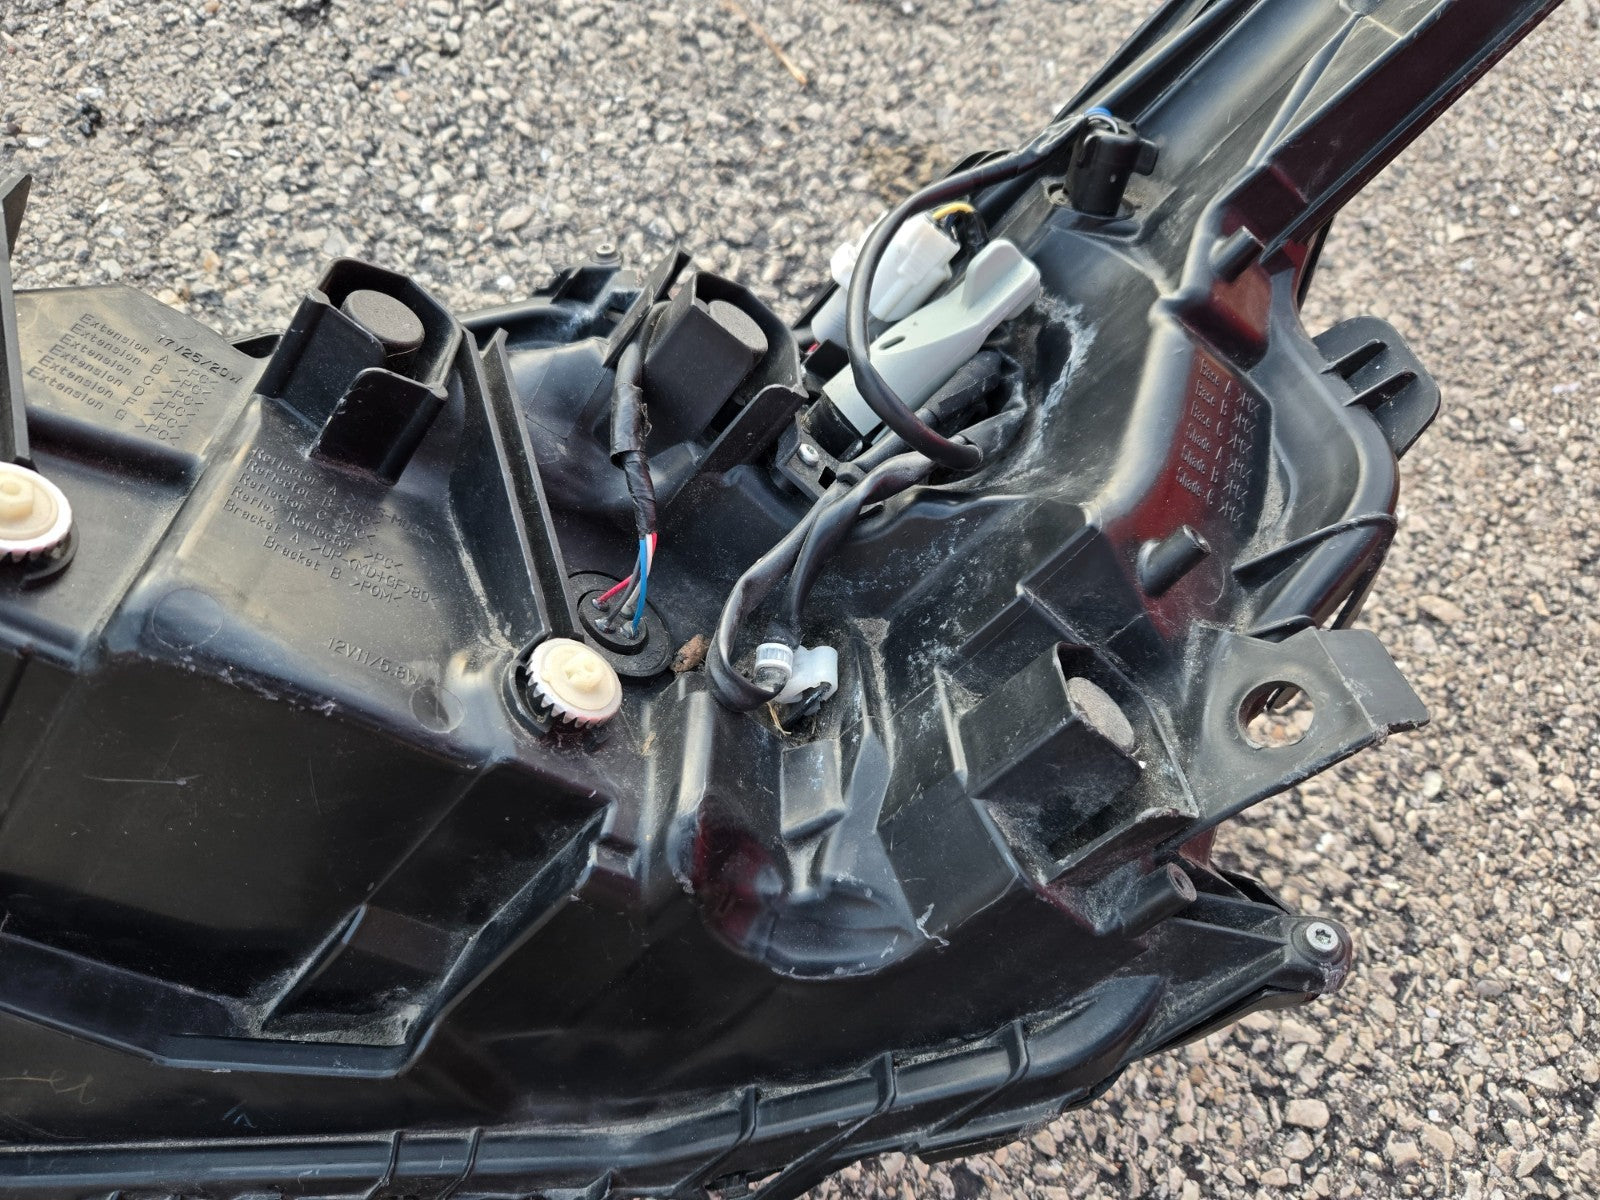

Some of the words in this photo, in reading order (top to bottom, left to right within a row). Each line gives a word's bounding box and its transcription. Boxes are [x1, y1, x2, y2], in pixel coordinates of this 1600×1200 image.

[60, 333, 133, 376] Extension
[143, 375, 155, 386] C
[71, 323, 143, 366] Extension
[150, 363, 163, 375] B
[79, 313, 151, 356] Extension
[158, 355, 169, 366] A
[26, 365, 104, 411] Extension
[114, 408, 128, 421] G
[38, 355, 114, 399] Extension
[122, 396, 138, 406] F
[49, 343, 123, 388] Extension
[131, 385, 145, 396] D
[238, 472, 306, 511] Reflector
[316, 510, 328, 521] C
[246, 459, 311, 499] Reflector
[322, 497, 333, 508] B
[252, 446, 319, 487] Reflector
[328, 484, 338, 496] A
[223, 499, 281, 534] Bracket
[290, 532, 300, 544] A
[231, 485, 277, 515] Reflex
[286, 511, 353, 550] Reflector
[263, 535, 321, 571] Bracket
[330, 566, 342, 580] B
